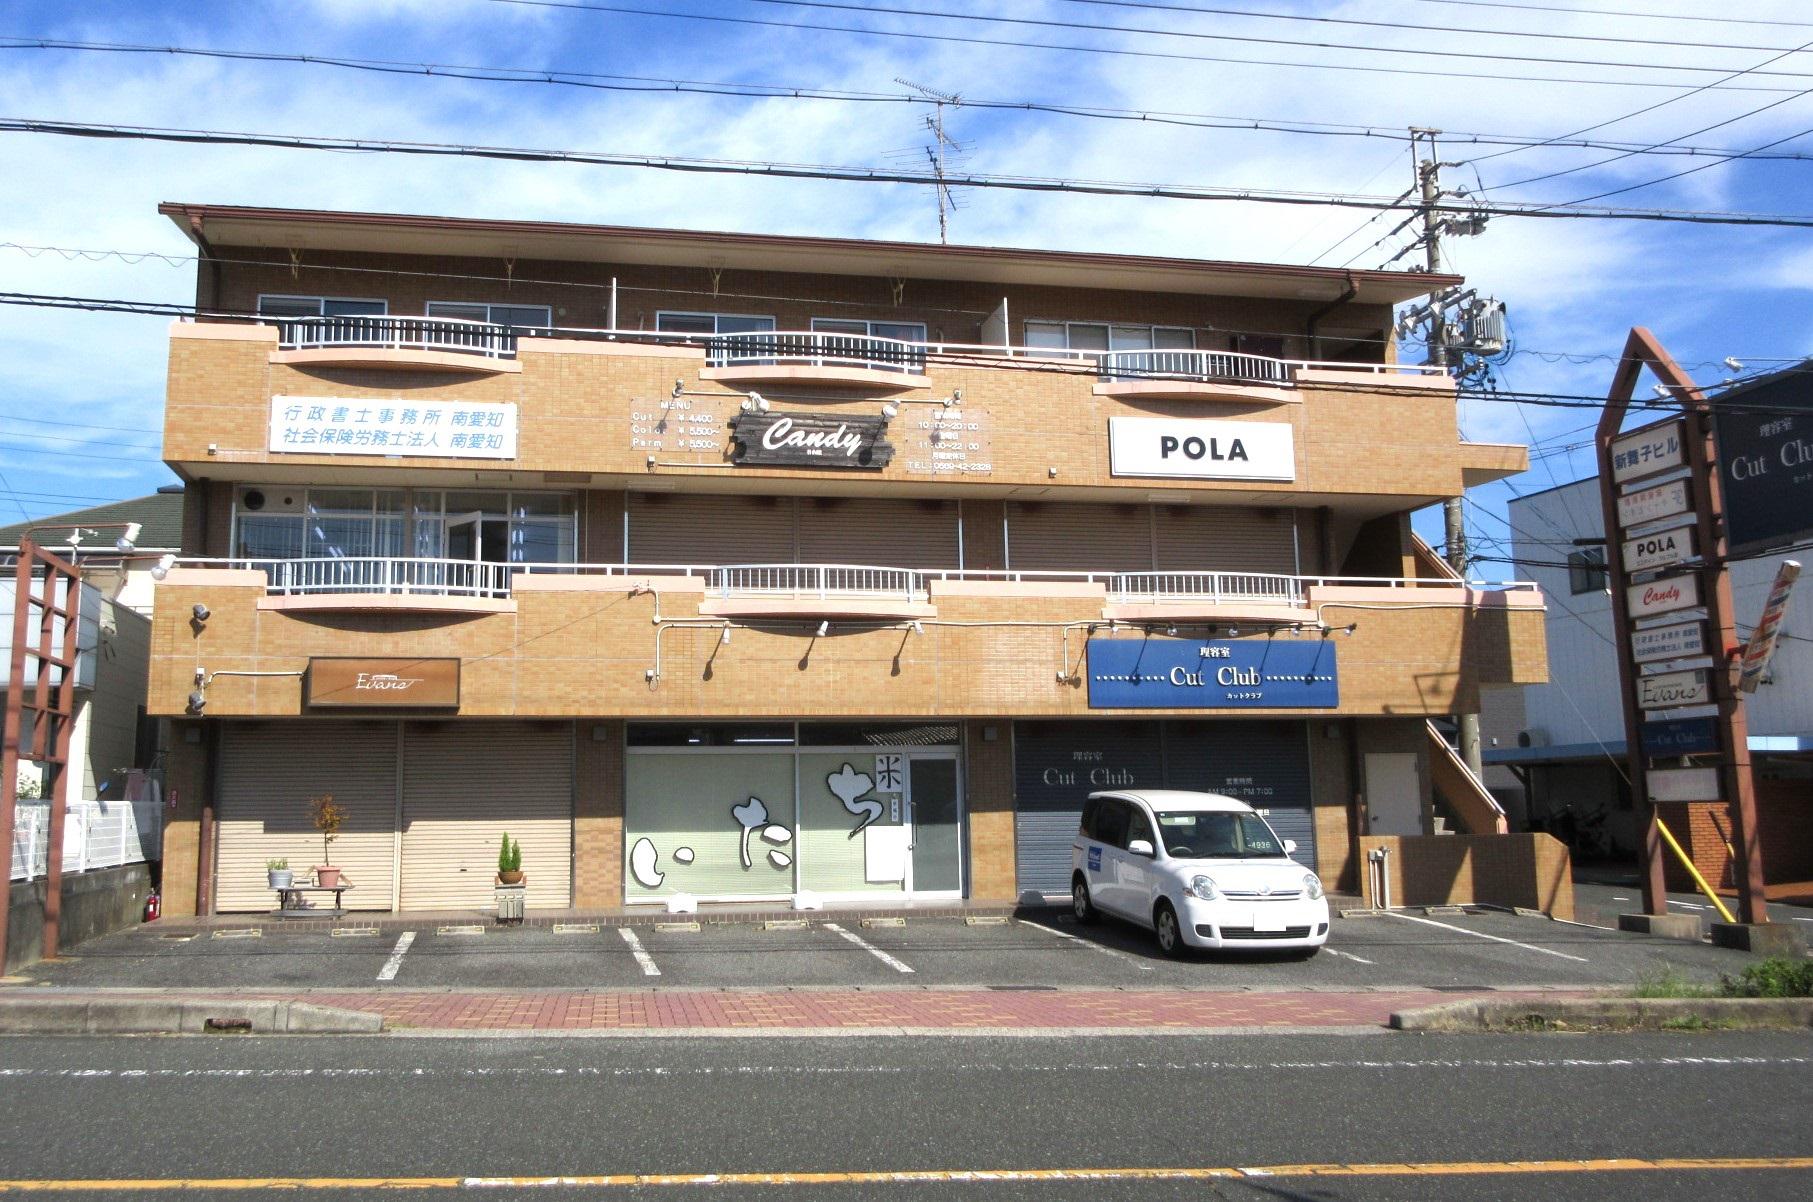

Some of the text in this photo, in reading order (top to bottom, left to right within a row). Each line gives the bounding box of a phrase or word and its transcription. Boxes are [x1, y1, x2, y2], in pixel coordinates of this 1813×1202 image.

[660, 401, 691, 410] MENU
[284, 405, 504, 428] 行政書士事務所 南愛知
[632, 412, 653, 421] Cut
[283, 427, 503, 450] 社会保険労務士法人 南愛知
[762, 417, 862, 457] Candy
[1161, 436, 1249, 462] POLA
[1731, 456, 1768, 480] Cut
[1637, 536, 1676, 557] POLA
[1643, 585, 1680, 606] Candy
[1200, 646, 1231, 658] 理容室
[355, 673, 414, 690] Evans
[1170, 666, 1262, 686] Cut Club
[1226, 692, 1262, 700] カットクラブ
[878, 755, 901, 789] 米
[1043, 768, 1134, 785] Cut Club
